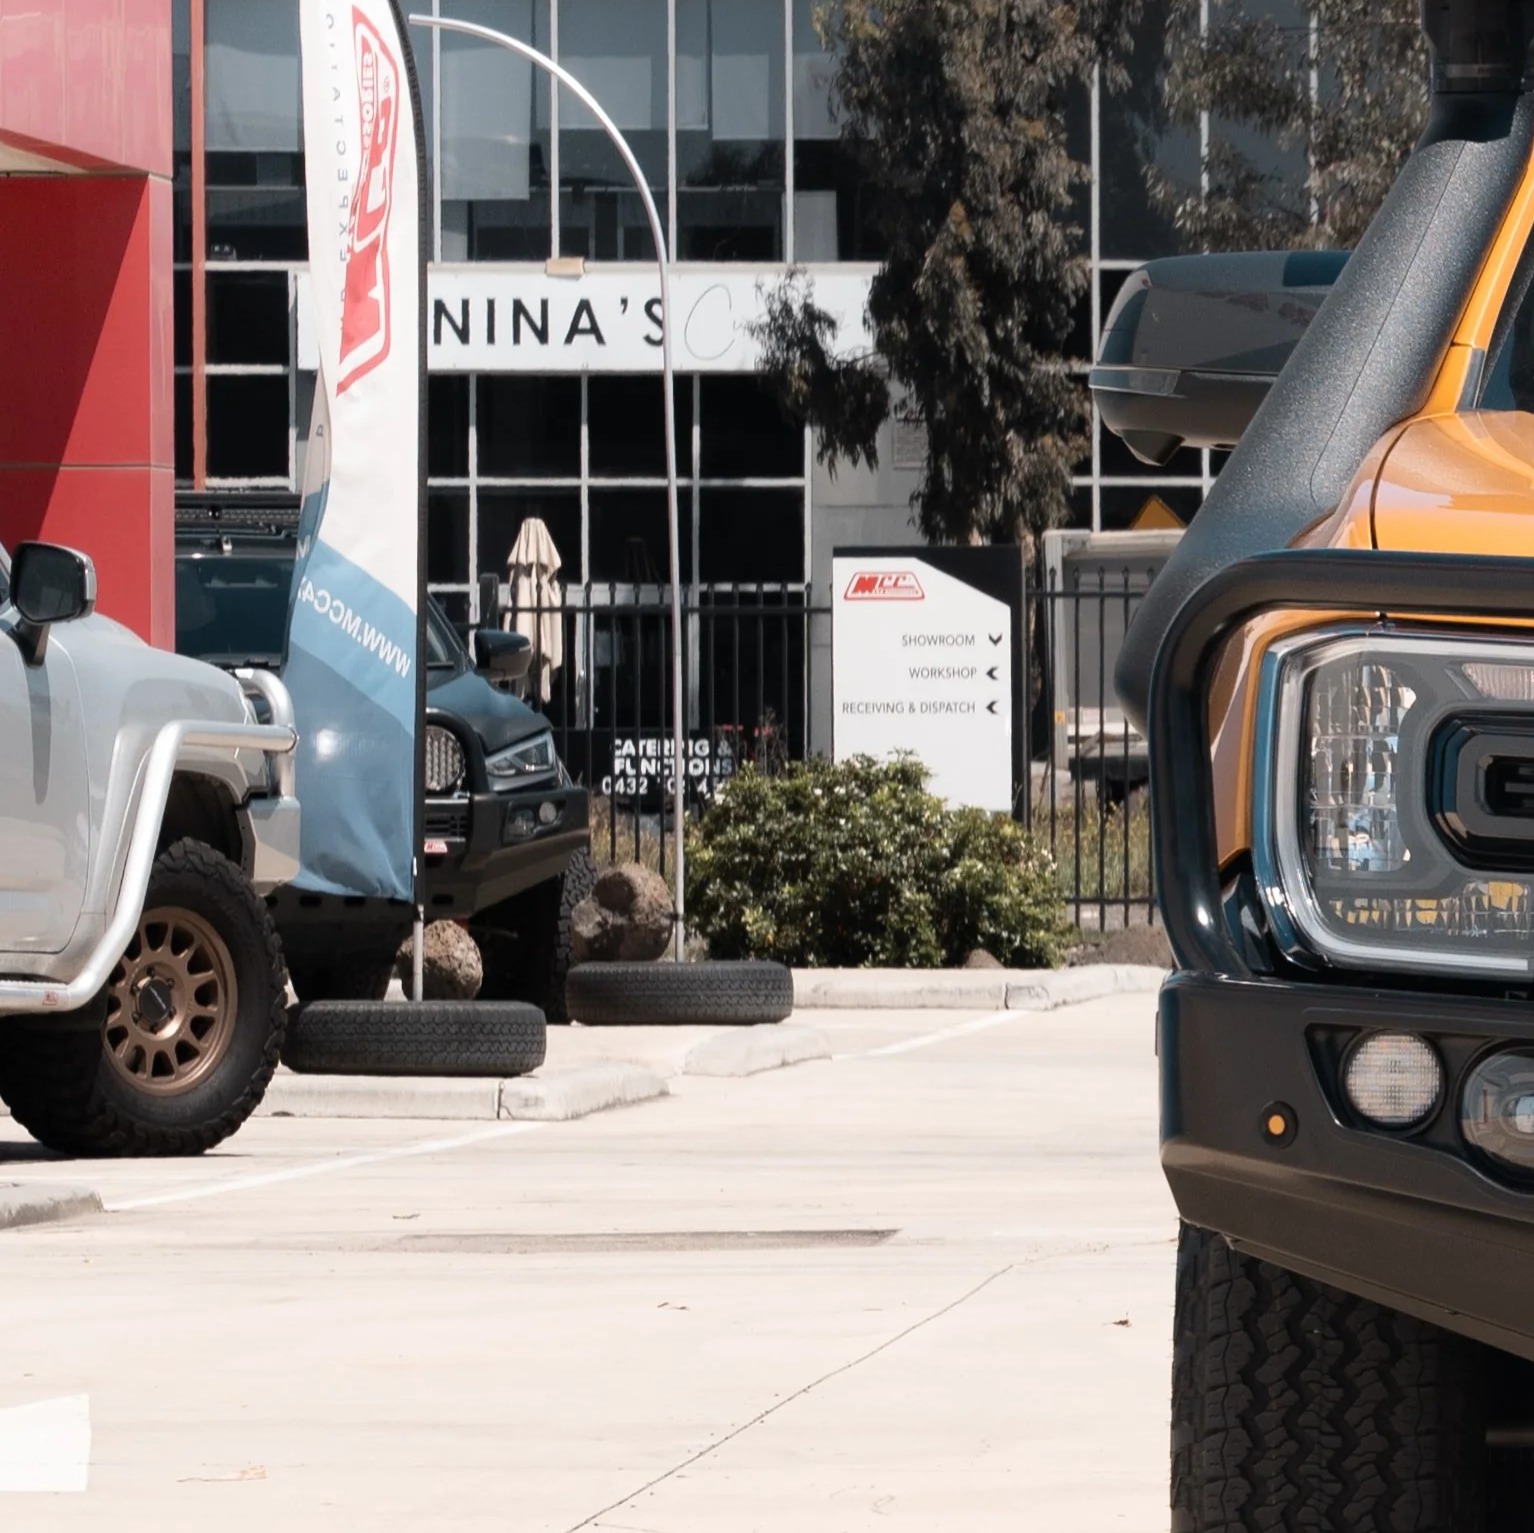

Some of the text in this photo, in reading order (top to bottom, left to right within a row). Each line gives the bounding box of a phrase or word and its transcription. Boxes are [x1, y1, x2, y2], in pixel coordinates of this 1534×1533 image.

[433, 298, 664, 346] NINA'S
[902, 634, 975, 647] SHOWROOM
[908, 666, 977, 679] WORKSHOP
[842, 702, 975, 714] RECEIVING & DISPATCH
